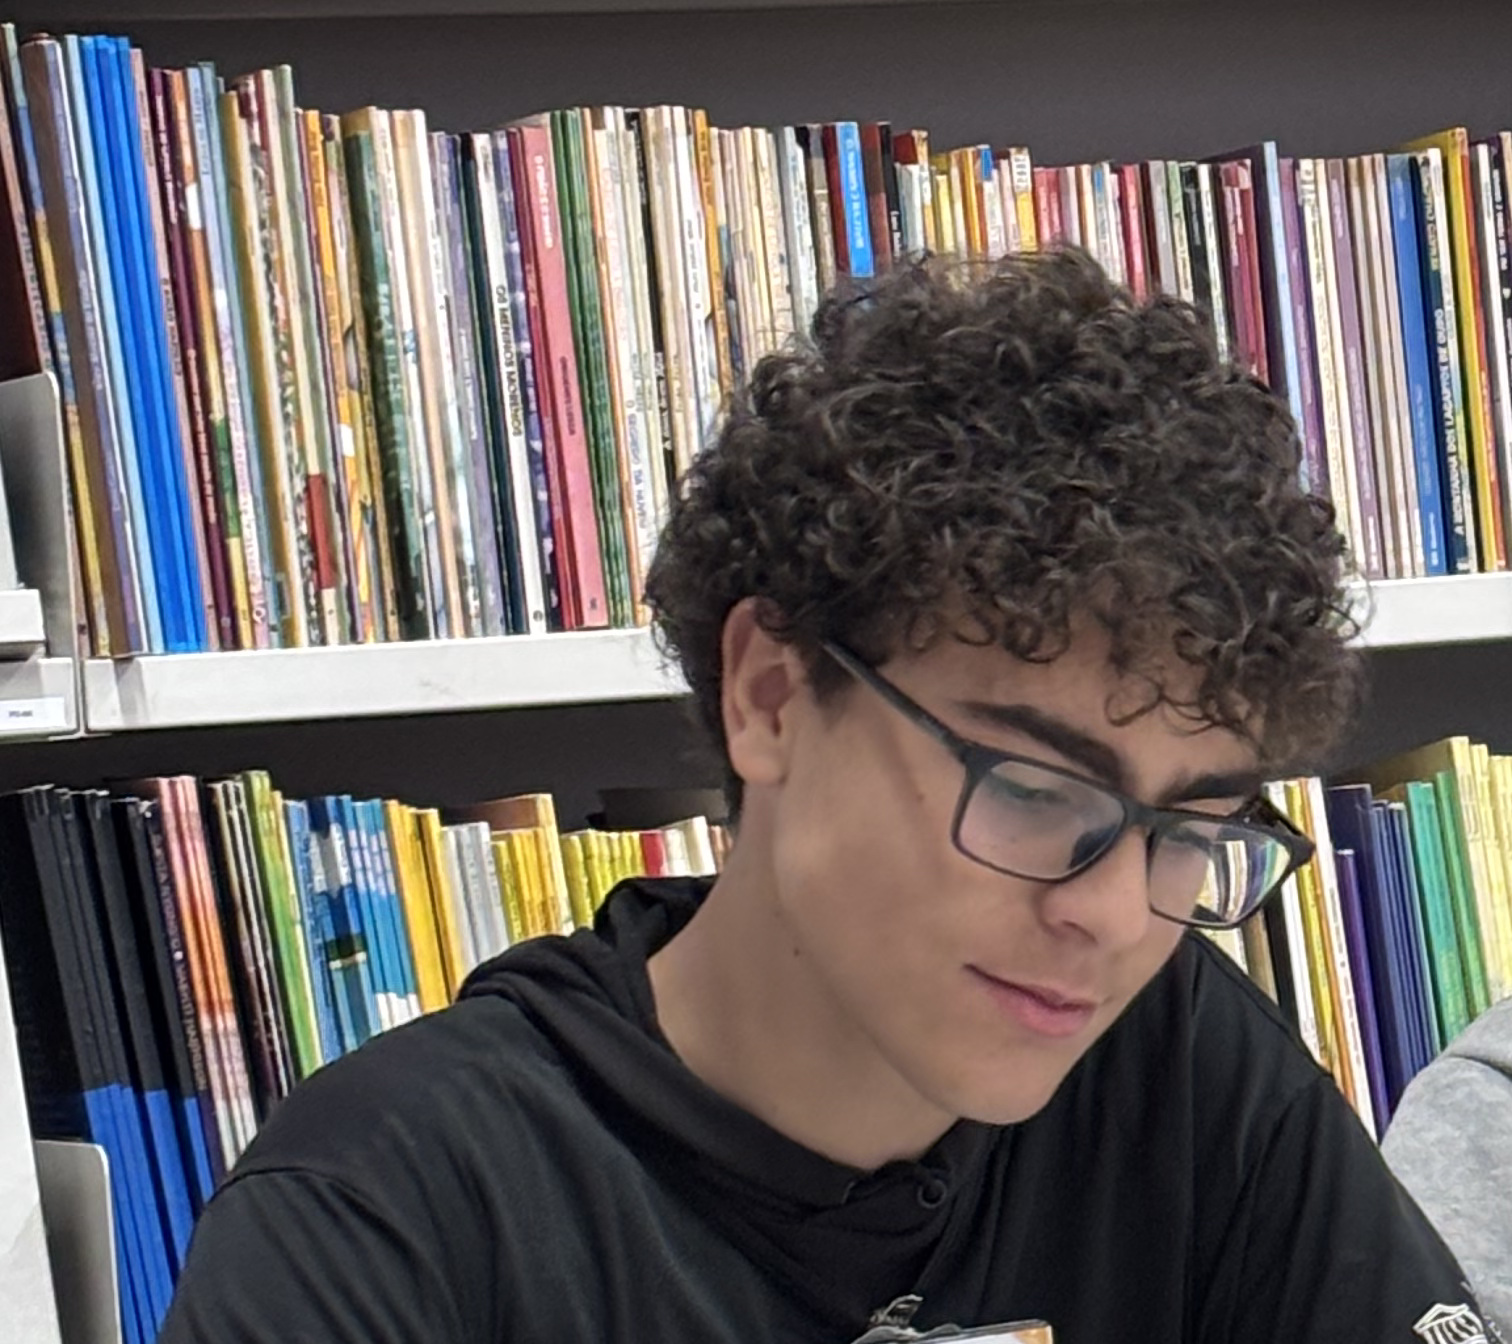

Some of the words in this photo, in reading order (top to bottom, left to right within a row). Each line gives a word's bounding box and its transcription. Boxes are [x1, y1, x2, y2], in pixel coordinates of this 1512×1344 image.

[494, 285, 507, 304] OS
[497, 307, 514, 369] MENINOS
[503, 371, 522, 438] MORENOS
